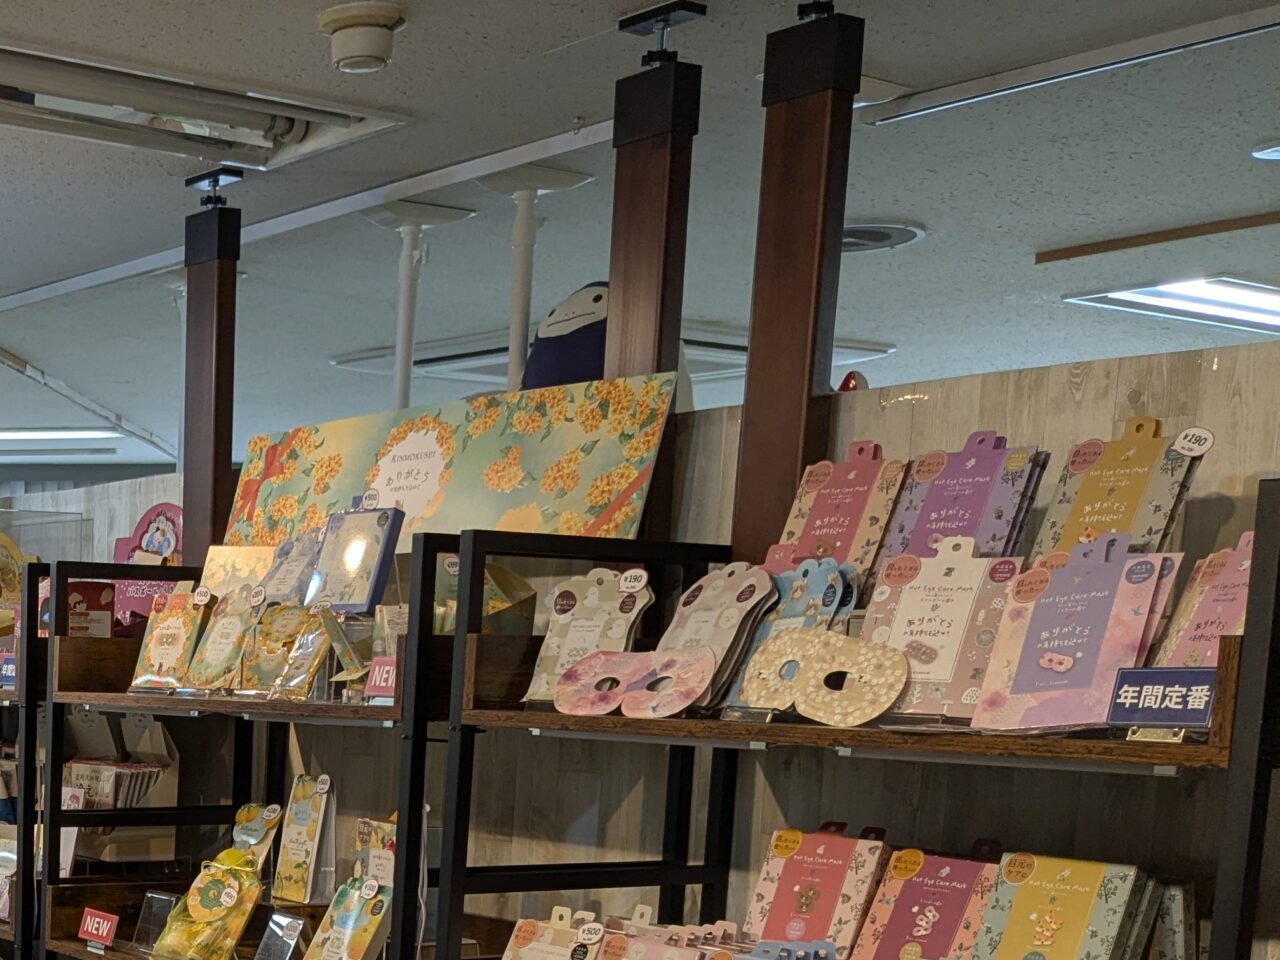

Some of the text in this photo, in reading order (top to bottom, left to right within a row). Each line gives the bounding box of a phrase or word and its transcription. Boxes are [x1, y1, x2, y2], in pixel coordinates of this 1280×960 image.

[1182, 432, 1208, 447] ¥190
[385, 468, 429, 487] ありがとう
[930, 507, 971, 520] ありがとう
[1083, 499, 1127, 514] ありがとう
[815, 514, 850, 527] ありがとう
[624, 575, 642, 583] ¥190
[906, 615, 954, 628] ありがとう
[1040, 624, 1091, 640] ありがとう
[1116, 685, 1210, 710] 年間定番
[1007, 858, 1033, 869] 目元の
[84, 915, 111, 937] NEW
[582, 928, 601, 936] ¥500
